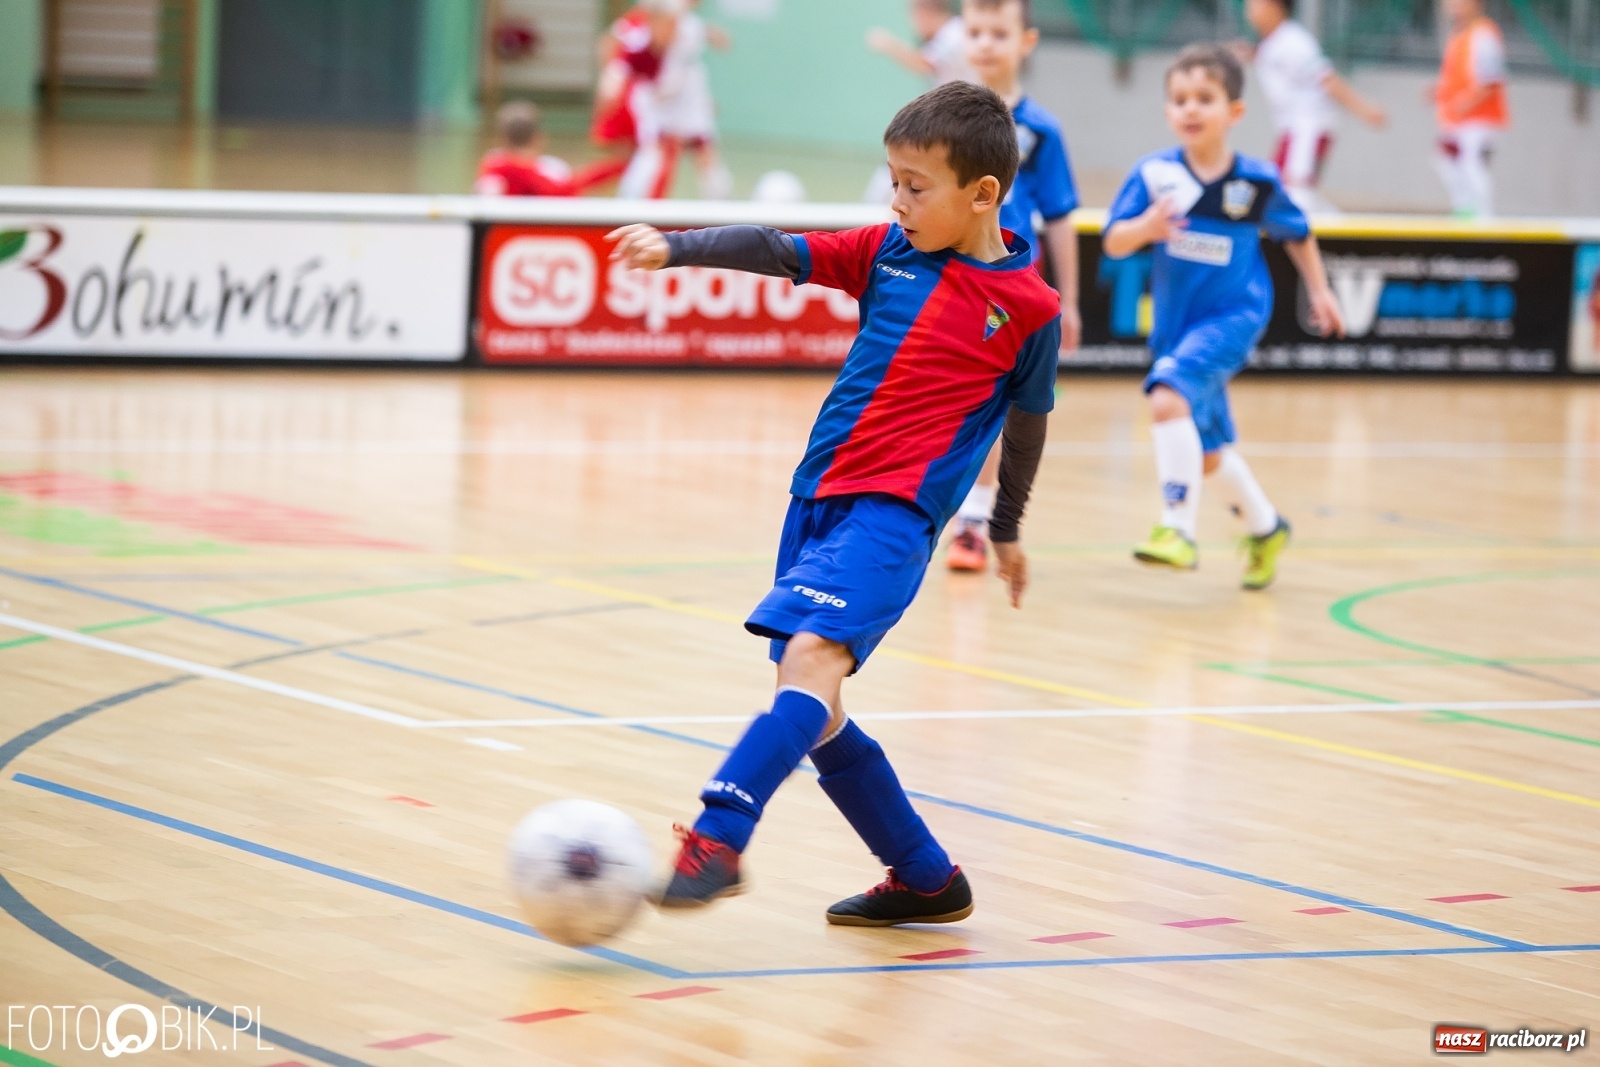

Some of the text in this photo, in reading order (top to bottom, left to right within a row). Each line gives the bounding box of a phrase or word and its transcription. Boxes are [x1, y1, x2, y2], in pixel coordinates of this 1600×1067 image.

[510, 256, 579, 309] SC
[876, 262, 917, 280] regio
[792, 584, 847, 609] regio
